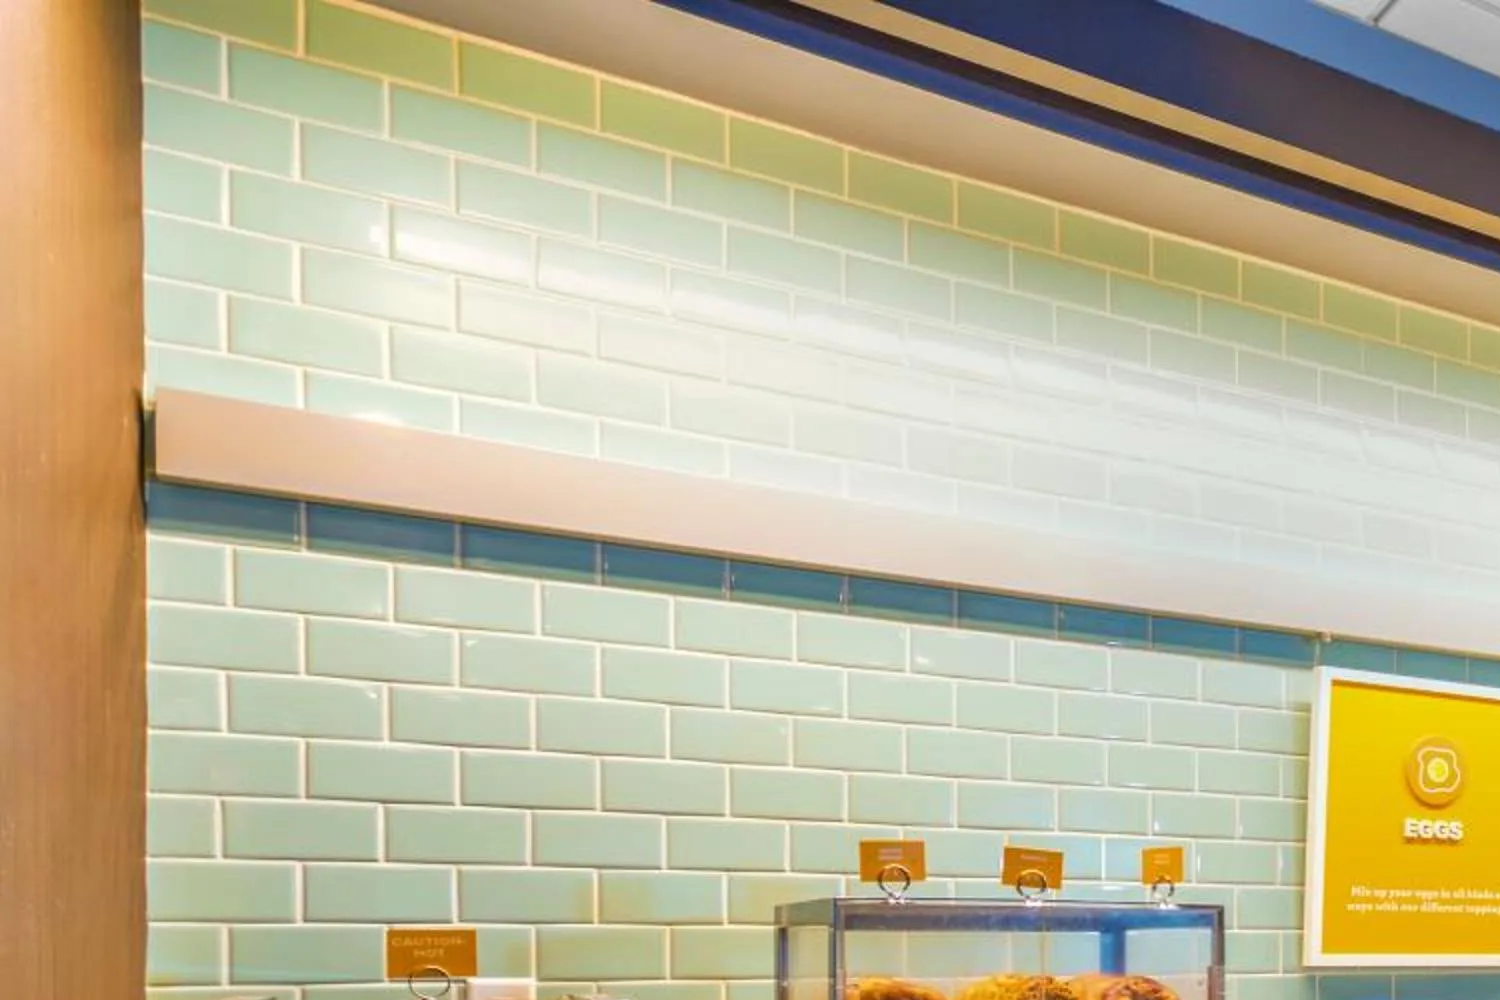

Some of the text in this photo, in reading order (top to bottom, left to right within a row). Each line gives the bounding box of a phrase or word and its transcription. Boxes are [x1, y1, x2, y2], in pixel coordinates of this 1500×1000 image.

[1404, 818, 1464, 841] EGGS
[1388, 889, 1412, 899] your
[1375, 900, 1399, 912] with
[1419, 901, 1463, 913] different
